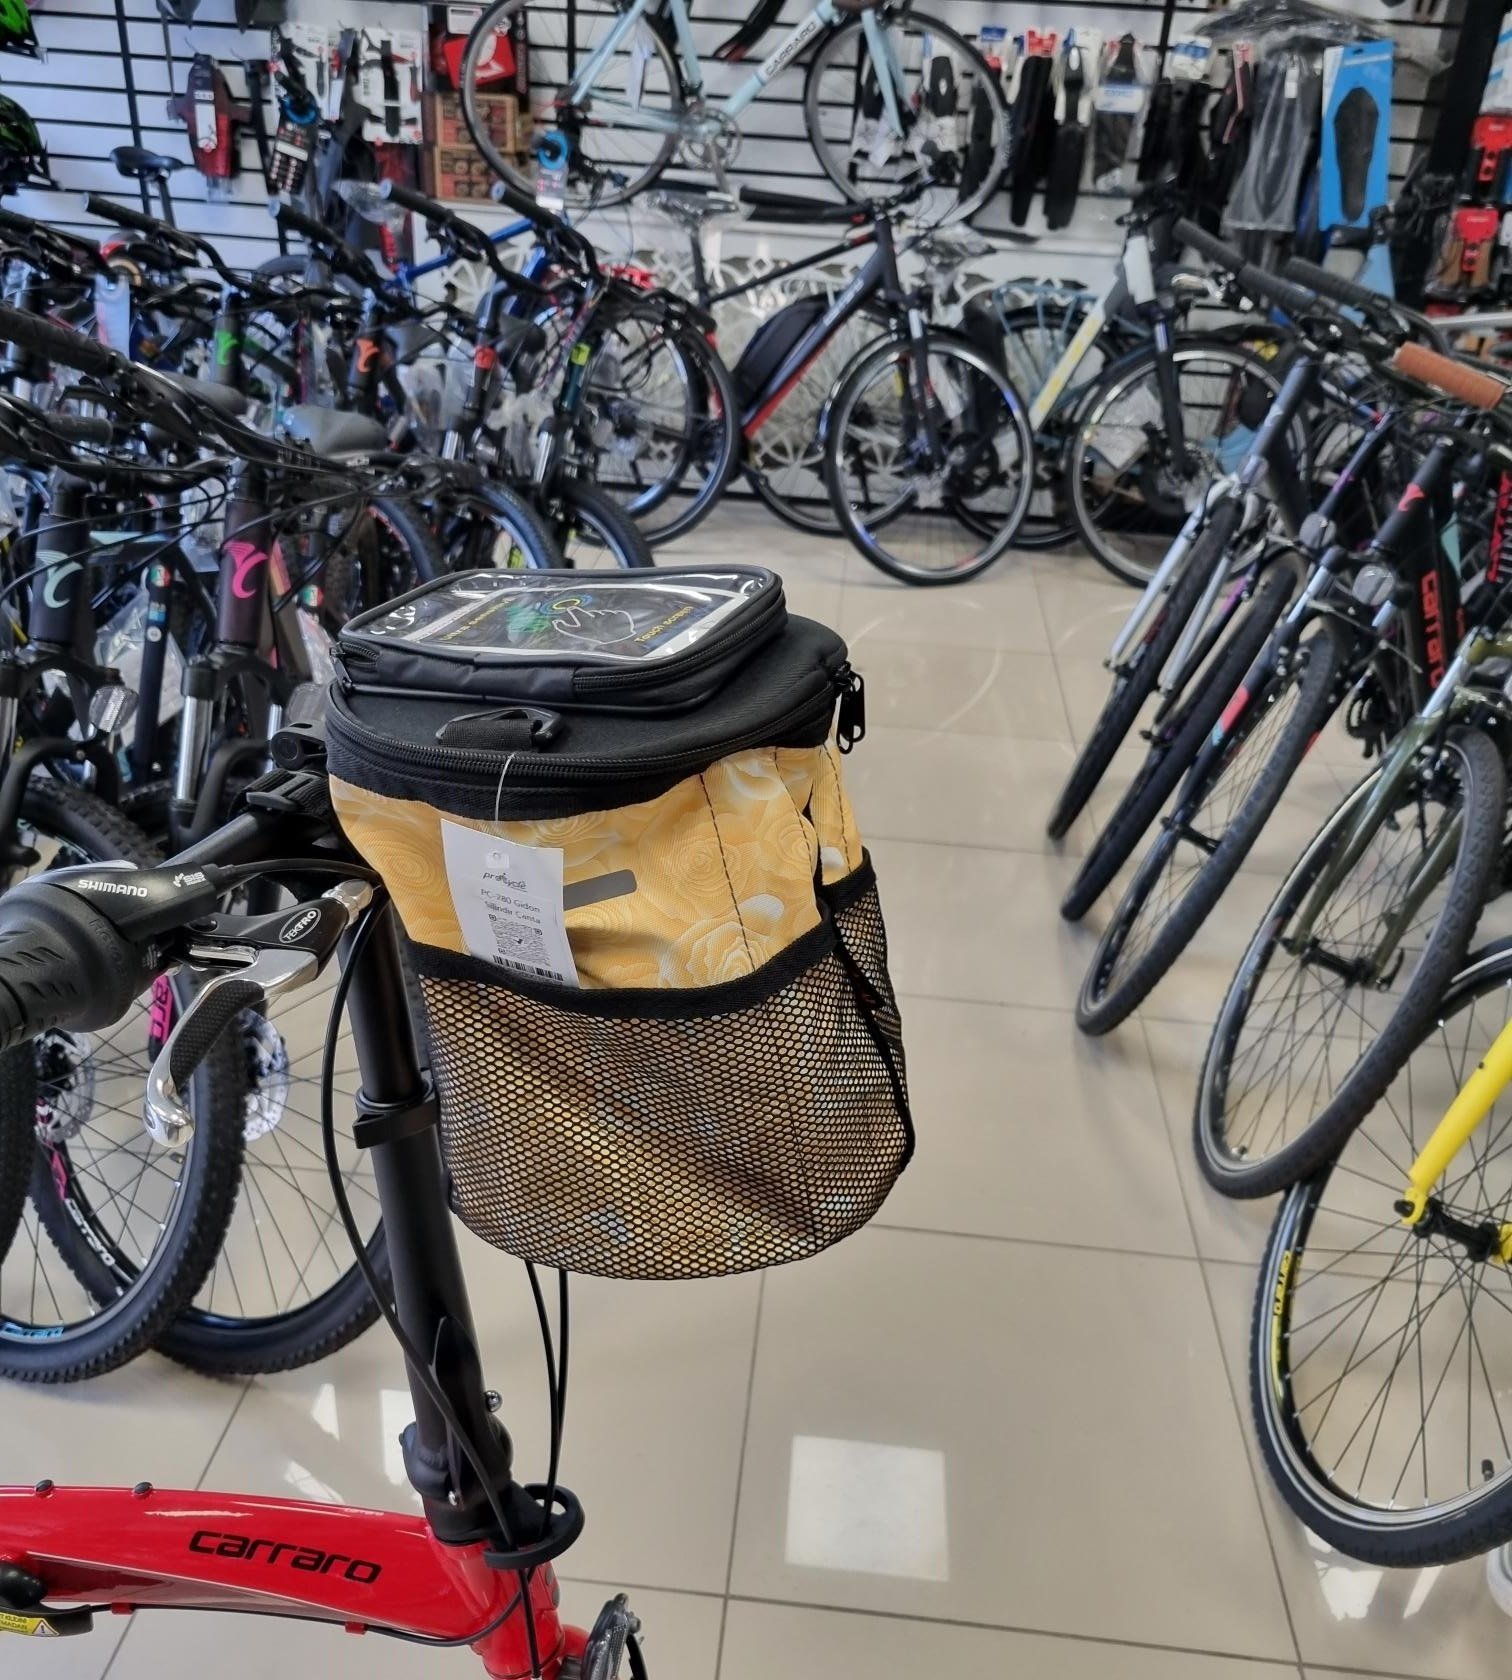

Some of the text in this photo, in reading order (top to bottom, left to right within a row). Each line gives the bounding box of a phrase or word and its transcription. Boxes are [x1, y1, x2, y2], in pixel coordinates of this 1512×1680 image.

[78, 879, 148, 898] SHIMANO
[282, 910, 317, 940] TEKTRO
[188, 1530, 382, 1585] carraro
